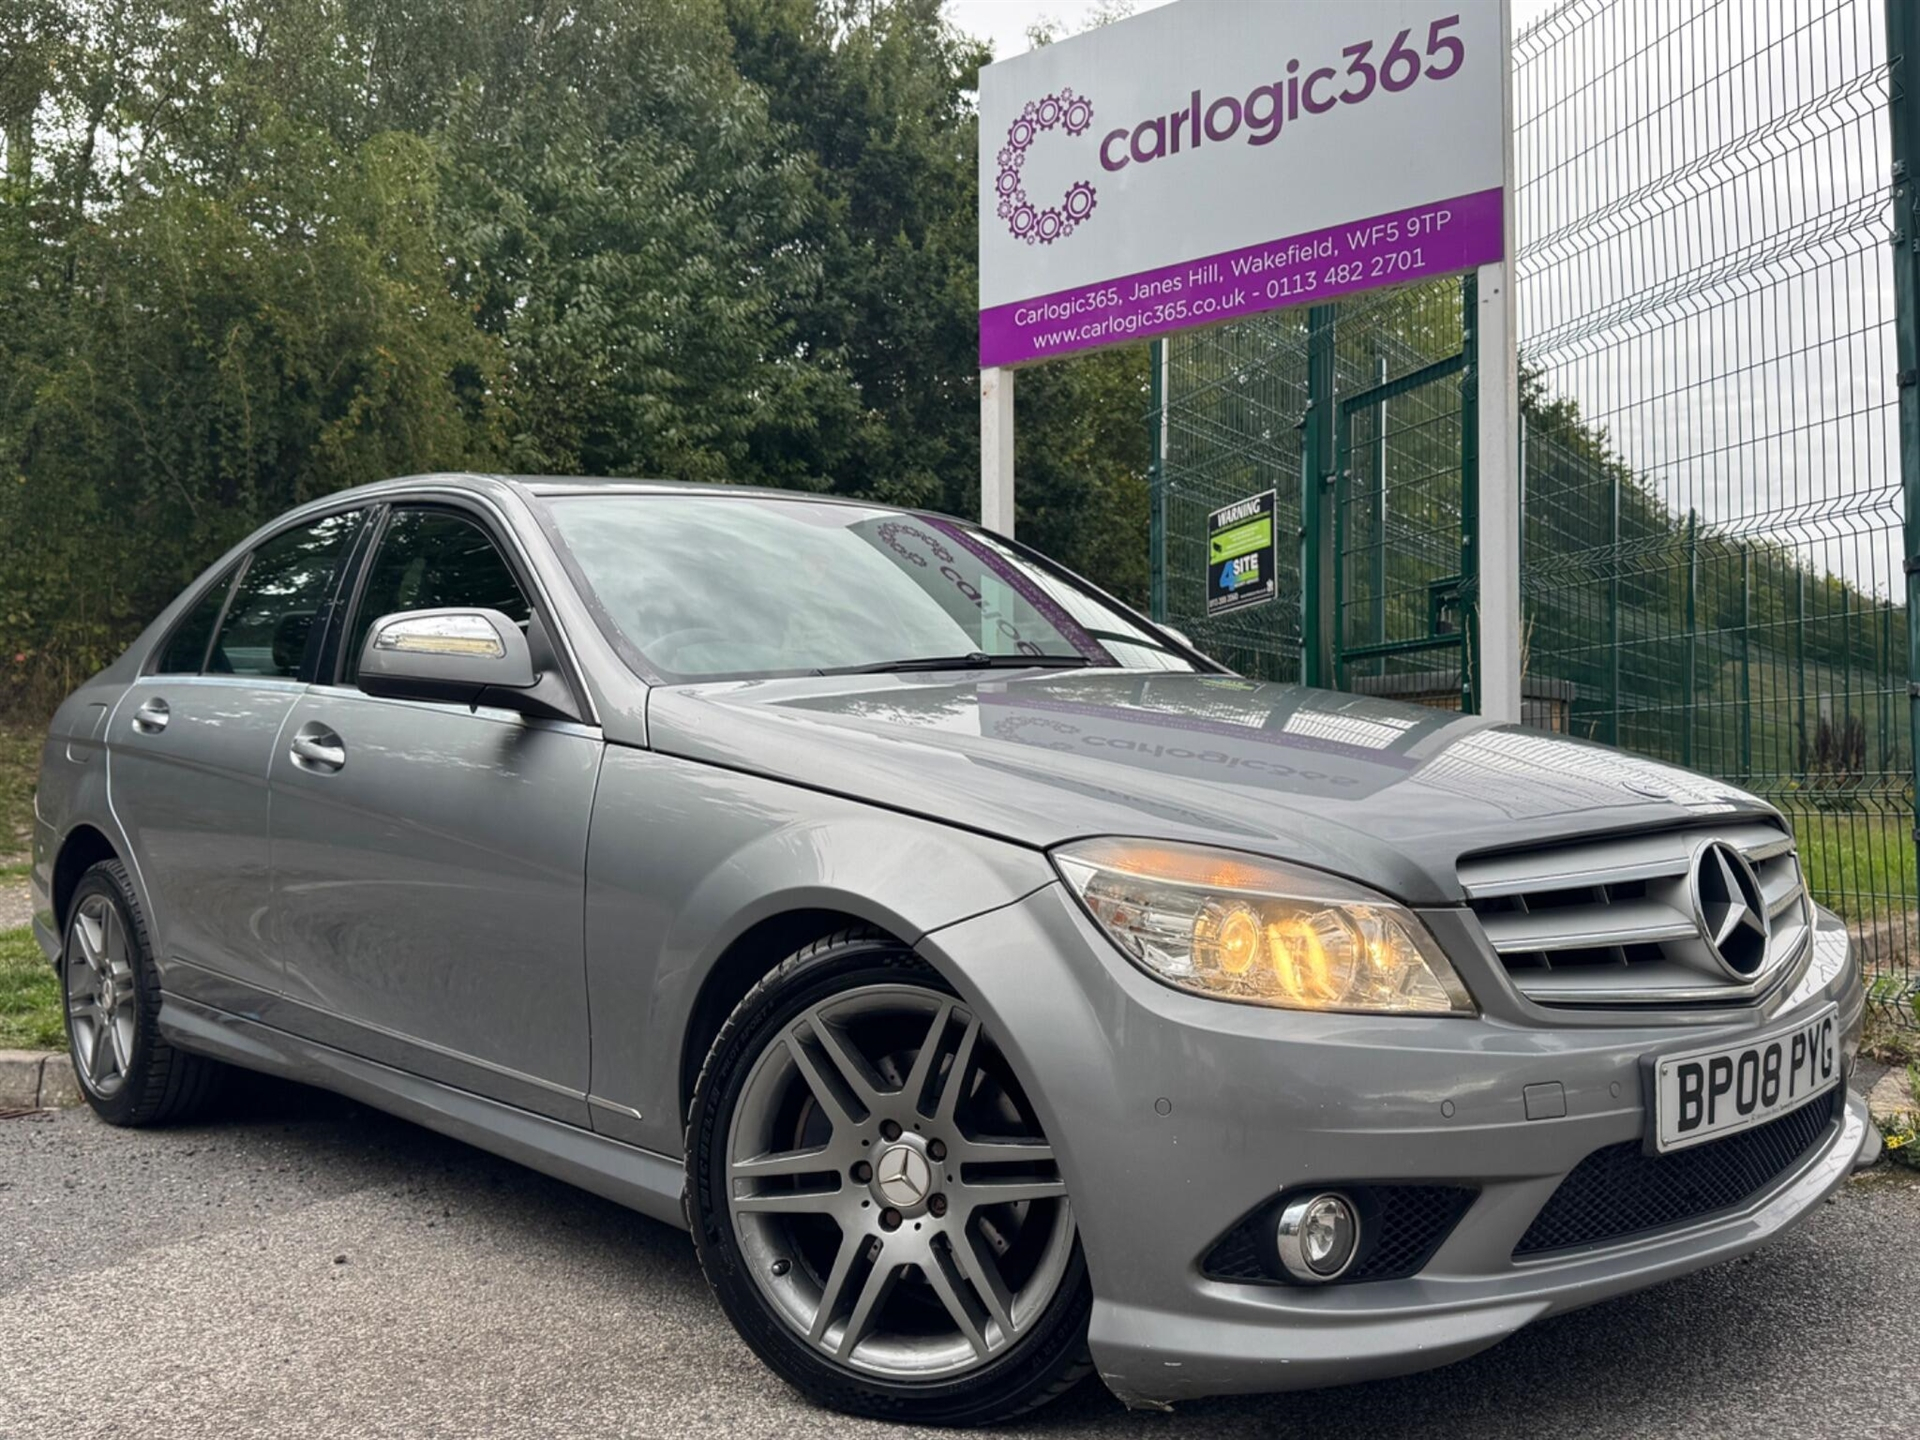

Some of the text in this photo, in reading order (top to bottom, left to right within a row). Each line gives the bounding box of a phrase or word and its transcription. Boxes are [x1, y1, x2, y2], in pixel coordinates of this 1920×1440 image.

[1099, 14, 1465, 172] carlogic365
[1014, 210, 1452, 326] Carlogic365, Janes Hill, Wakefield, WF5 9TP
[1033, 288, 1246, 349] www.carlogic365.co.uk
[1266, 271, 1317, 299] 0113
[1324, 260, 1364, 285] 482
[1370, 248, 1426, 277] 2701
[1217, 499, 1260, 527] WARNING
[1677, 1017, 1832, 1133] BP08 PYG
